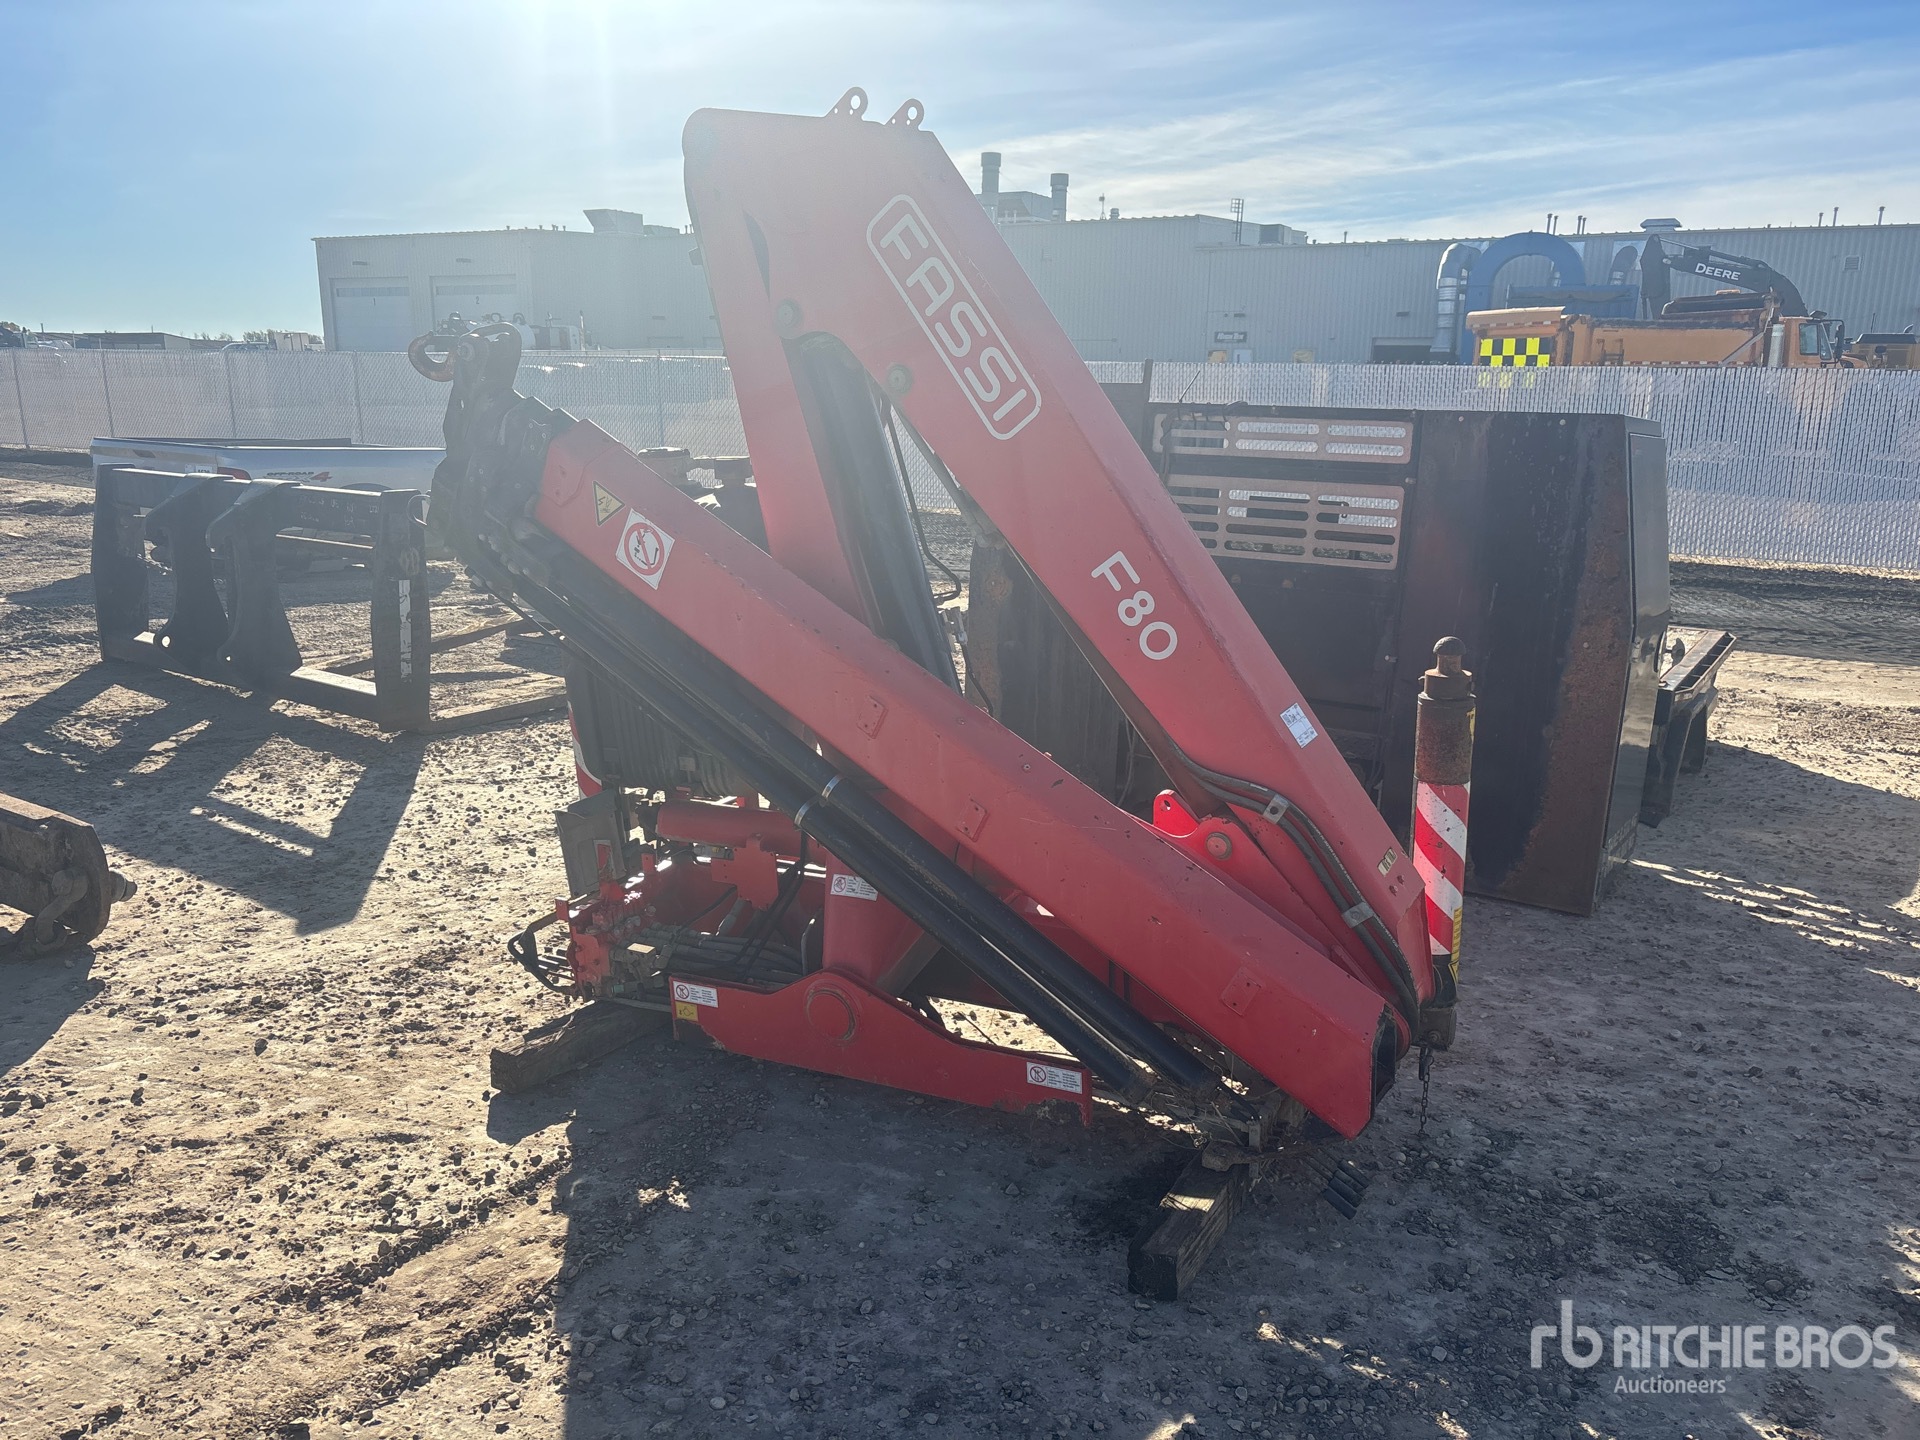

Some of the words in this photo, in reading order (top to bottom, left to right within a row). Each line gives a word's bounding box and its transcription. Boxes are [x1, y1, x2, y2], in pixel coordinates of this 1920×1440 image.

[475, 295, 480, 305] 2
[1695, 262, 1741, 281] DEERE
[880, 213, 1028, 422] FASSI
[1090, 550, 1178, 661] F80
